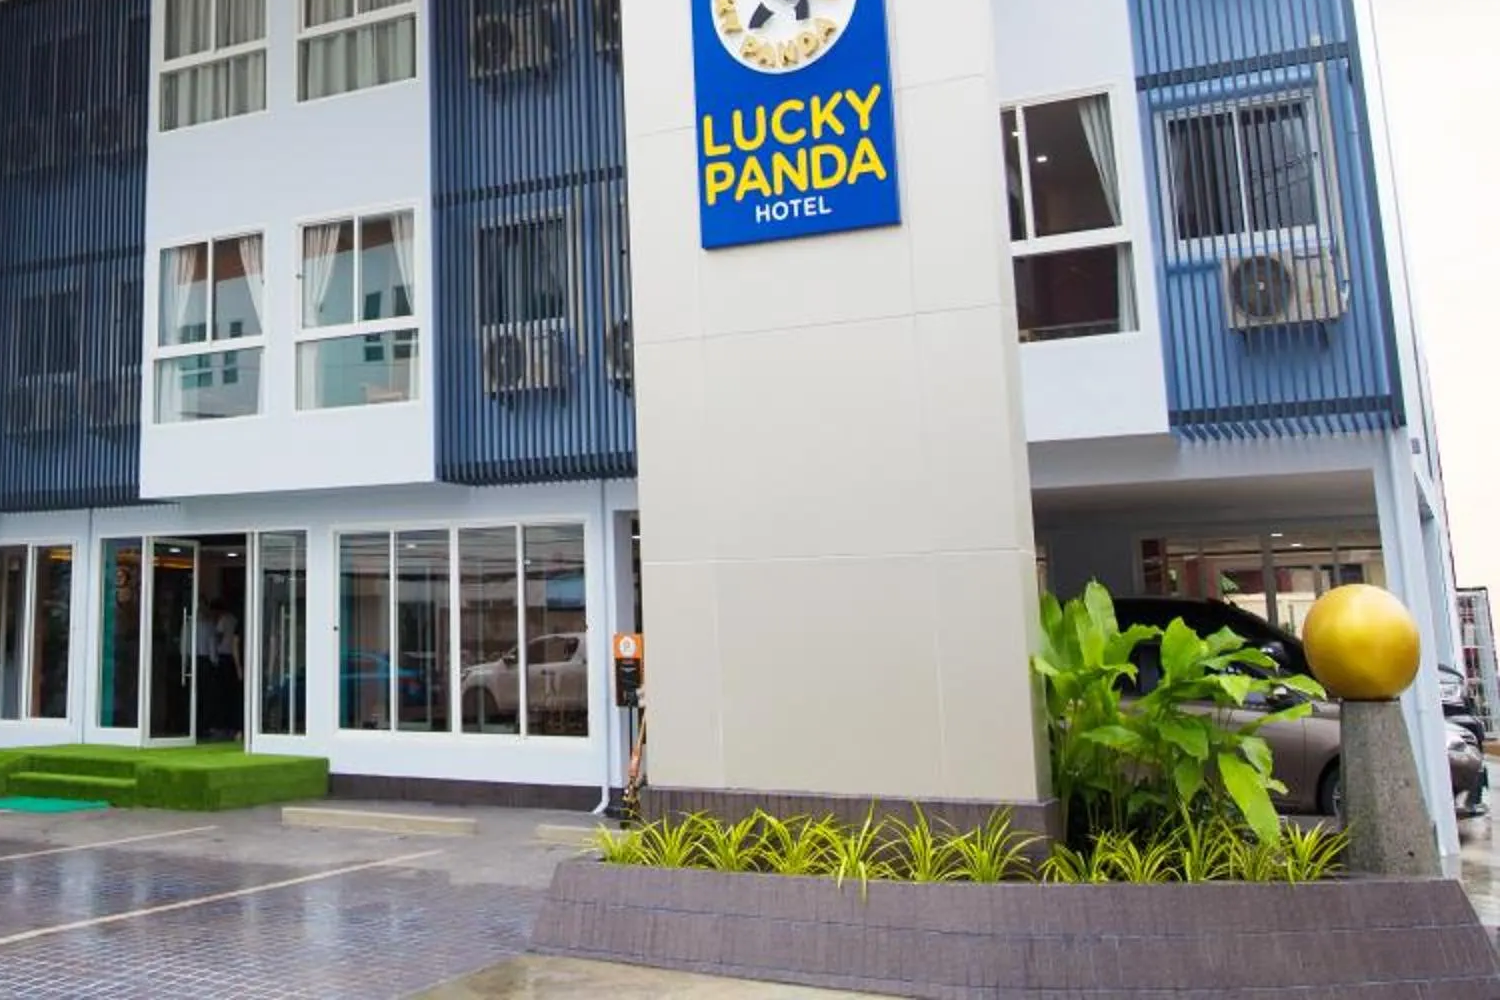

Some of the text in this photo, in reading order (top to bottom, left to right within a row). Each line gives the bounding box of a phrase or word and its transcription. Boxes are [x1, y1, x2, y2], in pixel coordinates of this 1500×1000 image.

[740, 18, 838, 69] PANDA
[703, 84, 881, 157] LUCKY
[704, 137, 886, 205] PANDA
[755, 196, 832, 223] HOTEL
